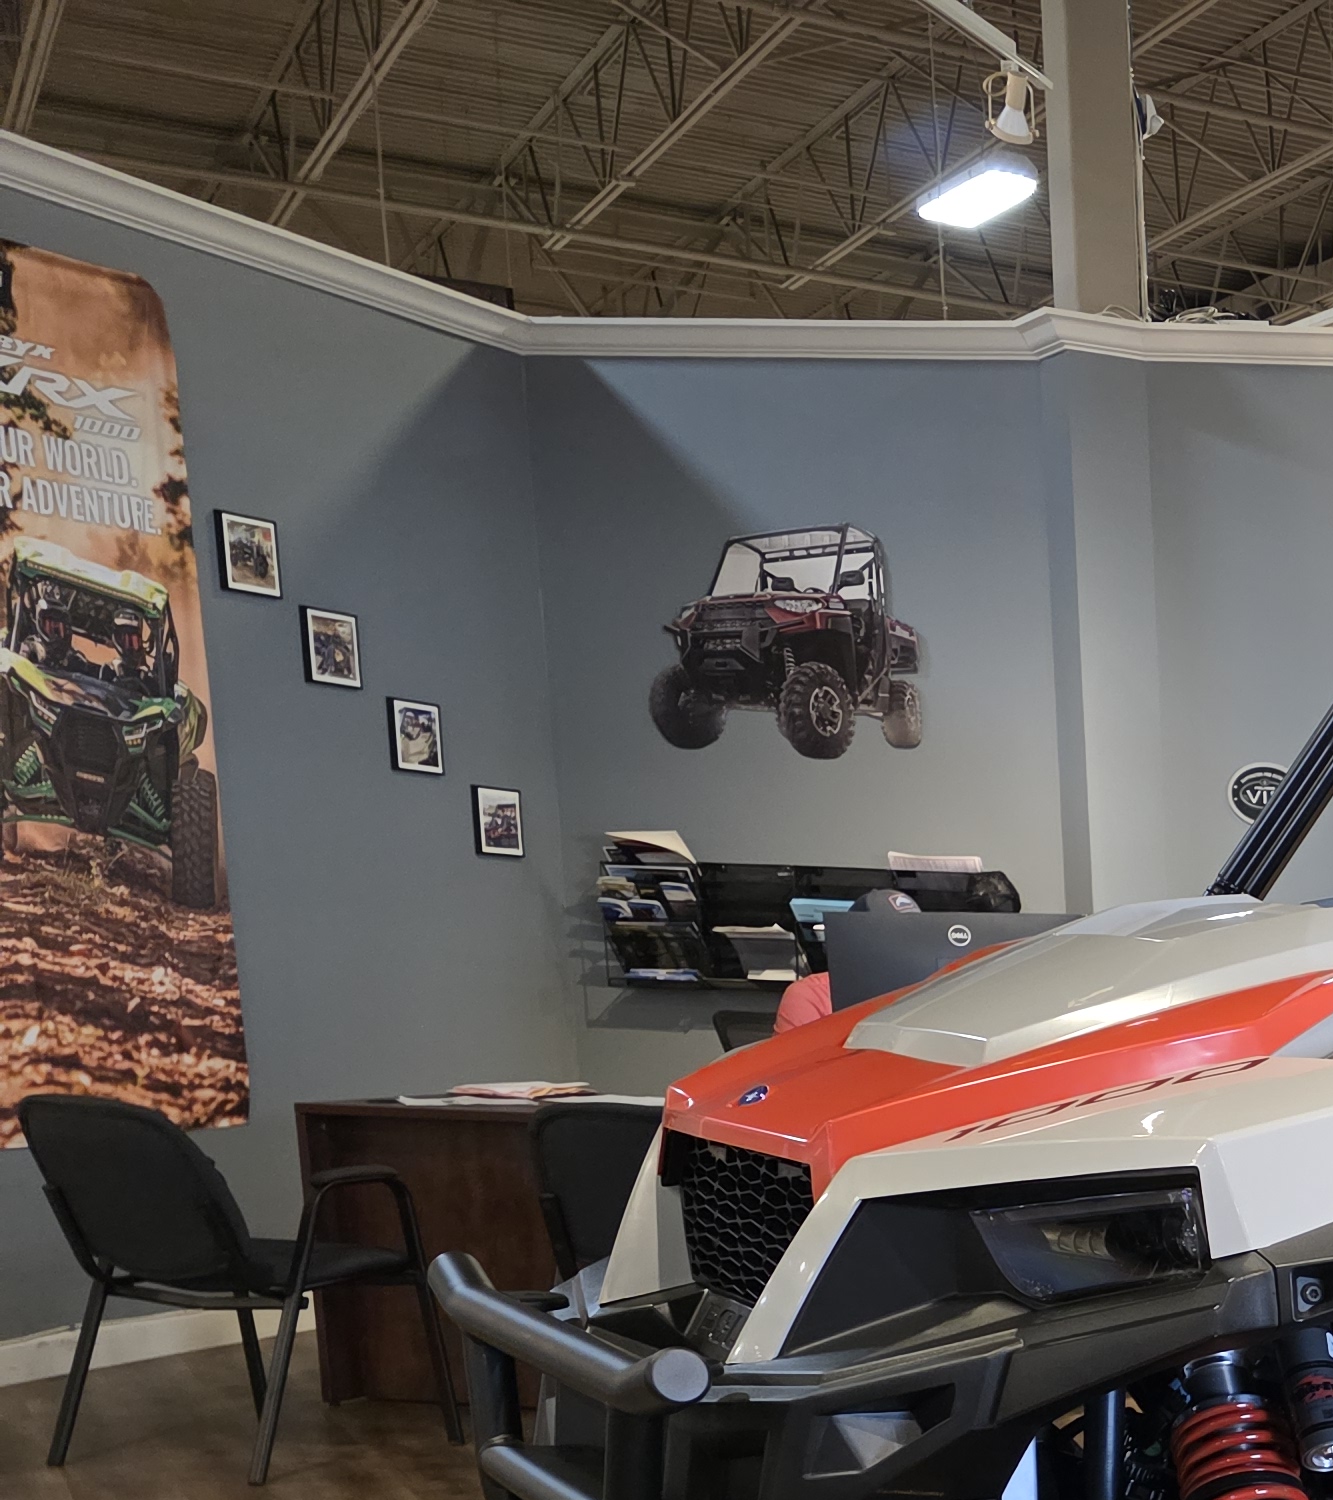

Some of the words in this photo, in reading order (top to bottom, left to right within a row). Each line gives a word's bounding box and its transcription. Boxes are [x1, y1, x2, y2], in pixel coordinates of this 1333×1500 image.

[74, 415, 140, 439] 1000
[42, 434, 137, 486] WORLD.
[22, 477, 161, 535] ADVENTURE.
[1246, 789, 1274, 804] VI
[944, 1058, 1270, 1142] 1000
